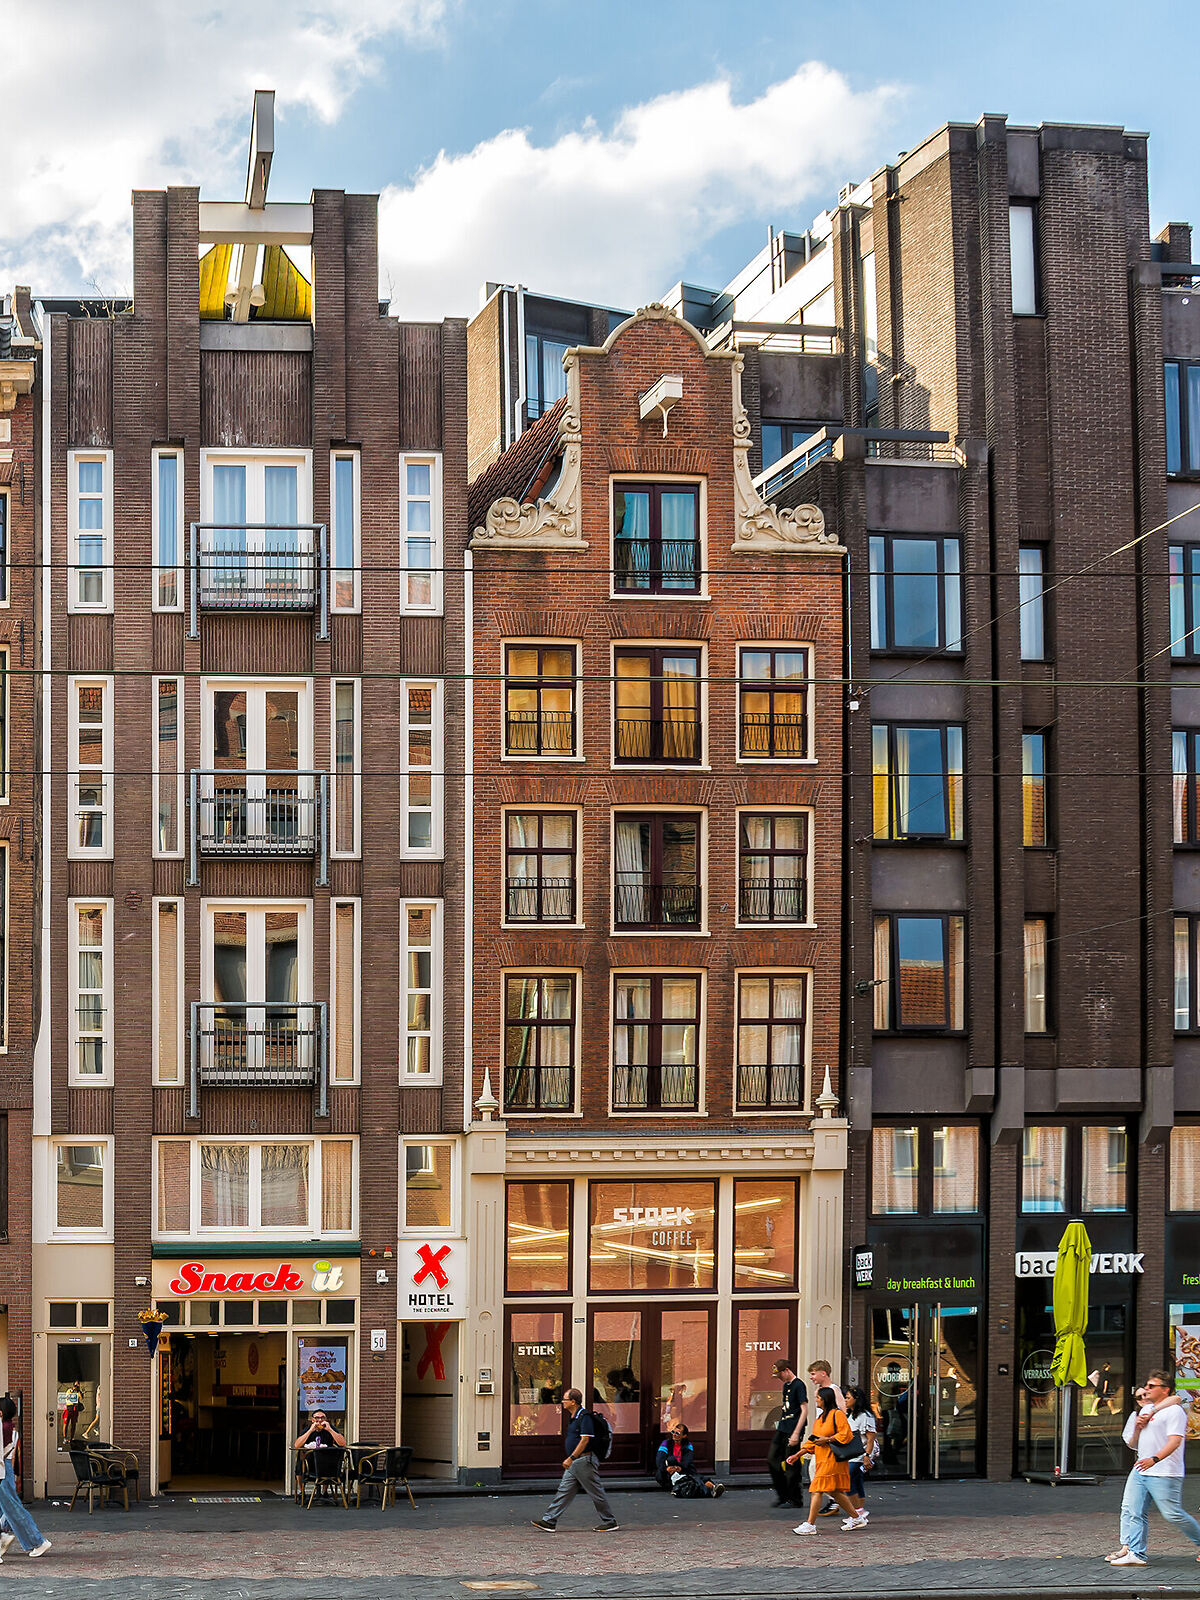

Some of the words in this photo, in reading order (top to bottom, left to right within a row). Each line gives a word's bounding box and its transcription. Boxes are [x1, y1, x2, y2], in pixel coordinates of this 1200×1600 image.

[613, 1206, 693, 1227] STOCK
[652, 1230, 692, 1246] COFFEE
[1020, 1254, 1056, 1275] bac
[169, 1261, 305, 1296] Snack
[311, 1259, 344, 1293] it
[855, 1269, 873, 1282] WERK
[1182, 1273, 1200, 1285] Fres
[886, 1278, 902, 1292] day
[903, 1276, 942, 1290] breakfast
[944, 1277, 951, 1289] &
[953, 1276, 976, 1289] lunch
[408, 1293, 455, 1306] HOTEL
[374, 1337, 385, 1349] 50
[745, 1341, 782, 1351] STOCK
[517, 1345, 555, 1356] STOCK
[1023, 1369, 1053, 1379] VERRASS
